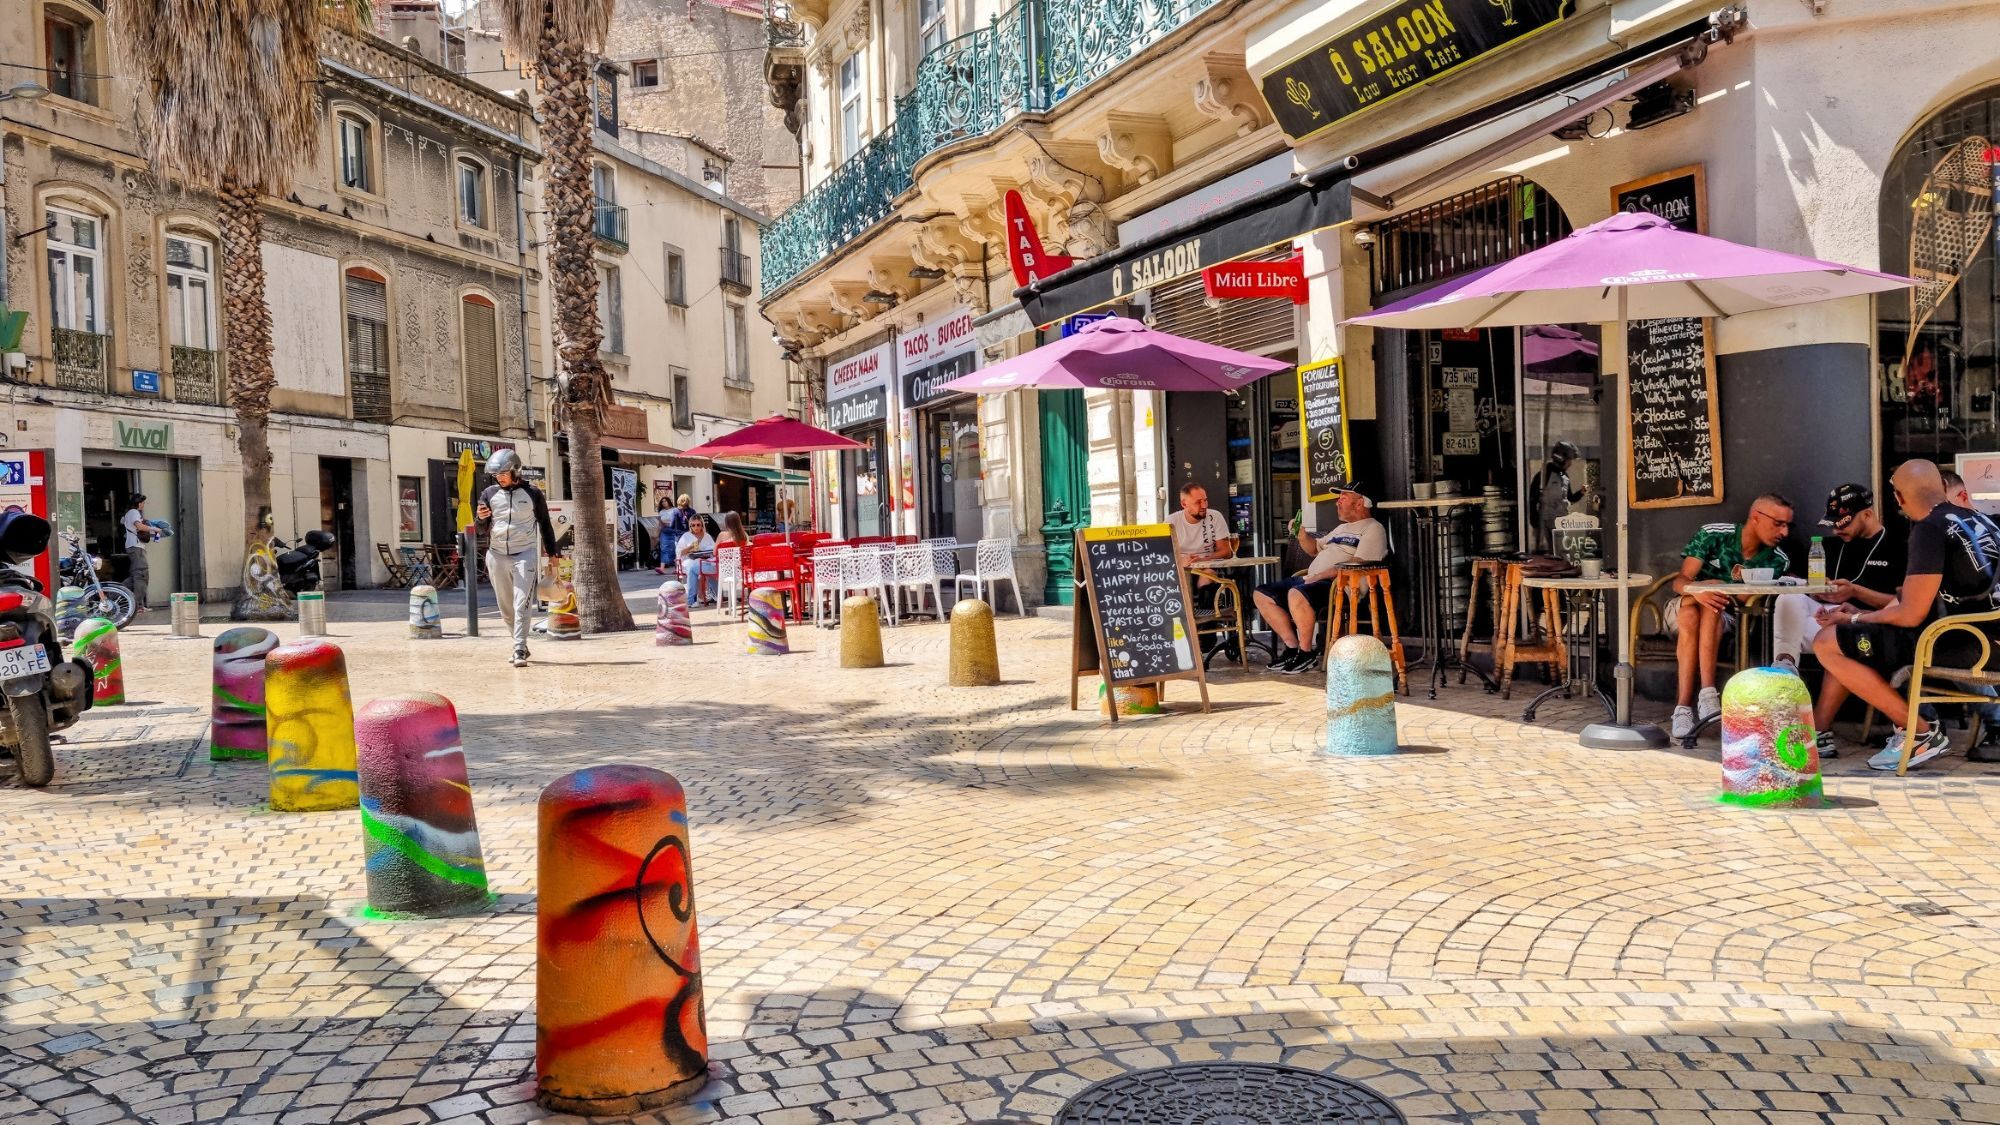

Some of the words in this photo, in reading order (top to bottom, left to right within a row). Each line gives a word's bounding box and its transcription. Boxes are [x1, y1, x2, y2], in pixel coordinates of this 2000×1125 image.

[1328, 48, 1353, 86] Ô
[1353, 0, 1457, 75] SALOON
[1112, 264, 1123, 297] Ô
[1132, 239, 1201, 291] SALOON
[1215, 272, 1252, 288] Midi
[1257, 272, 1299, 288] Libre
[904, 333, 929, 359] TACOS
[834, 361, 857, 386] CHEESE
[858, 351, 879, 378] NAAN
[913, 361, 960, 402] Oriental
[1099, 376, 1156, 387] Corona
[831, 406, 841, 428] Le
[842, 394, 879, 425] Palmier
[338, 440, 347, 448] 14
[1106, 527, 1148, 537] Schweppes
[1101, 573, 1140, 589] HAPPY
[1143, 570, 1176, 584] HOUR
[1107, 637, 1125, 648] like
[1109, 648, 1118, 658] it
[1111, 658, 1129, 669] like
[1113, 667, 1135, 678] that
